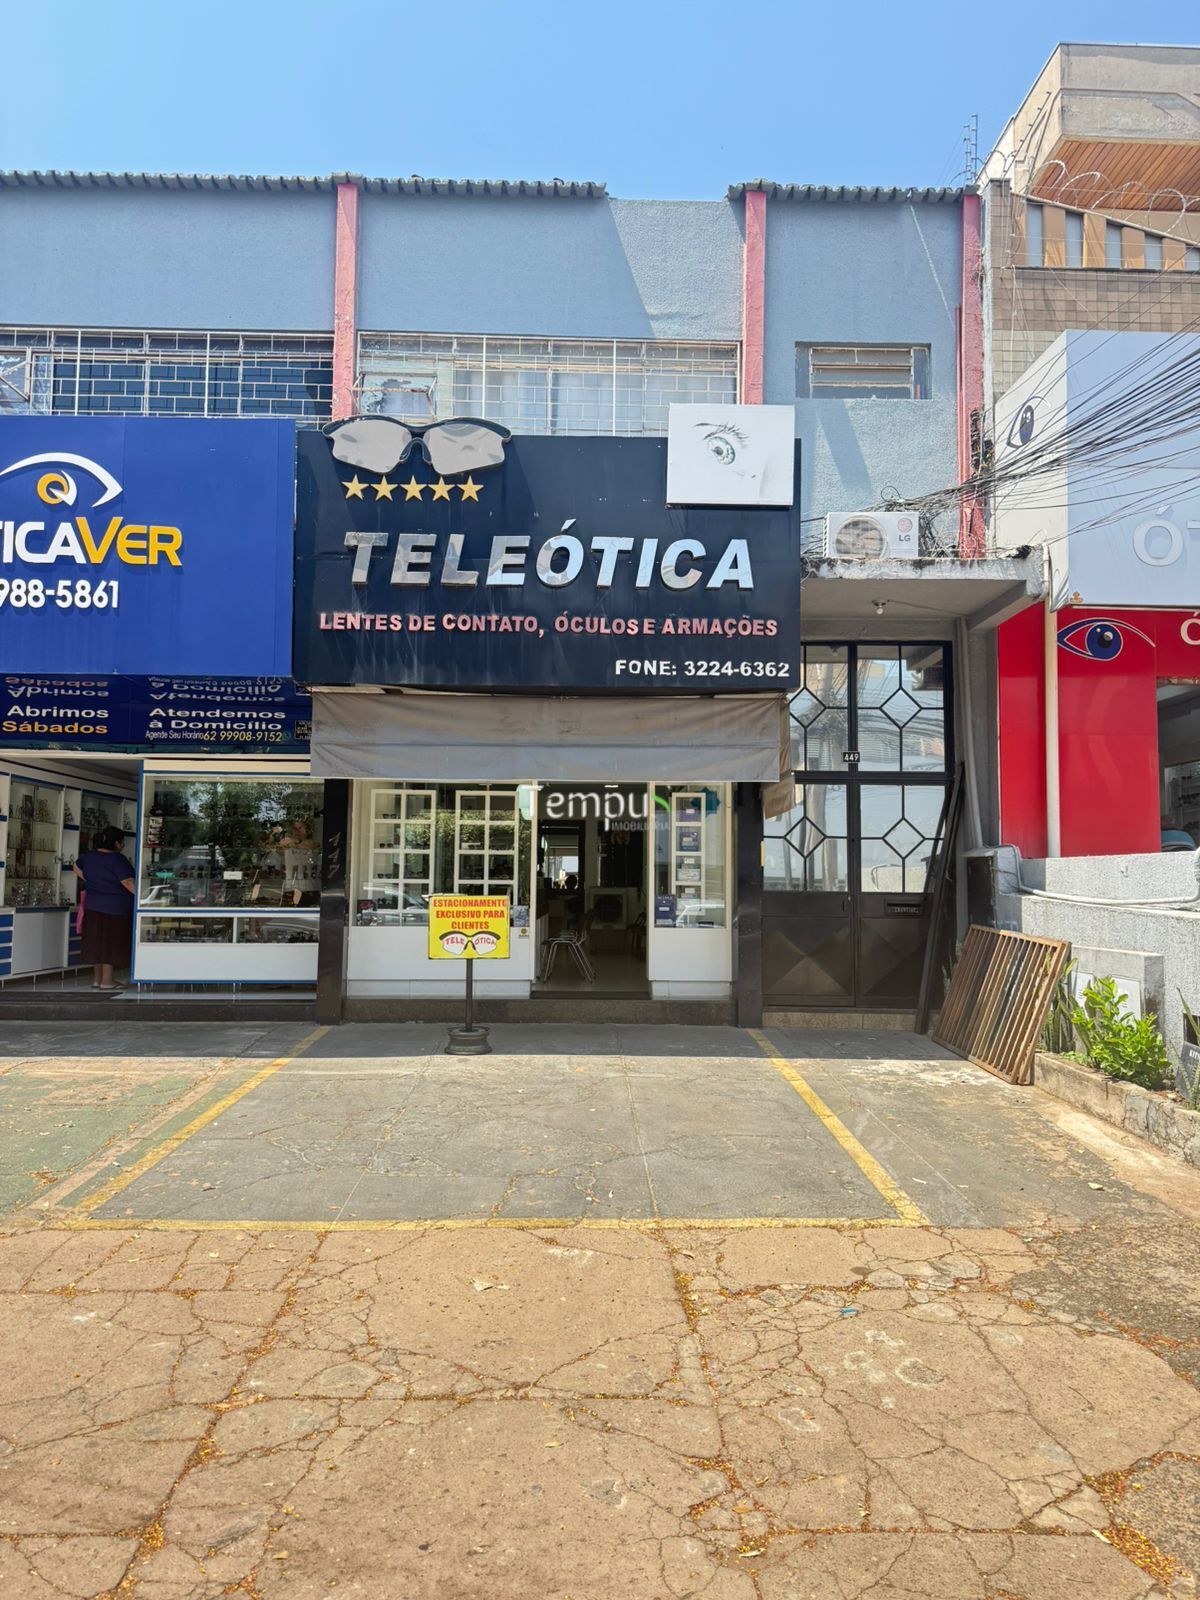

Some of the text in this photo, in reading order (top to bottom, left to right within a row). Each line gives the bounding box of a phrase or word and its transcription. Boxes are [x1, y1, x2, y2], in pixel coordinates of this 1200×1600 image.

[898, 534, 912, 542] LG
[343, 518, 755, 590] TELEÓTICA
[319, 610, 778, 638] LENTES DE CONTATO, ÓCULOS E ARMAÇÕES
[615, 659, 790, 677] FONE: 3224-6362
[7, 705, 109, 719] Abrimos
[149, 707, 286, 719] Atendemos
[2, 720, 108, 734] Sábados
[170, 720, 282, 730] Domicílio
[145, 730, 168, 740] Agende
[169, 730, 181, 739] Seu
[203, 730, 217, 741] 62
[220, 730, 282, 742] 99908-9152
[844, 753, 859, 761] 449
[436, 910, 505, 919] EXCLUSIVO PARA
[451, 921, 489, 930] CLIENTES
[445, 936, 465, 945] TELE
